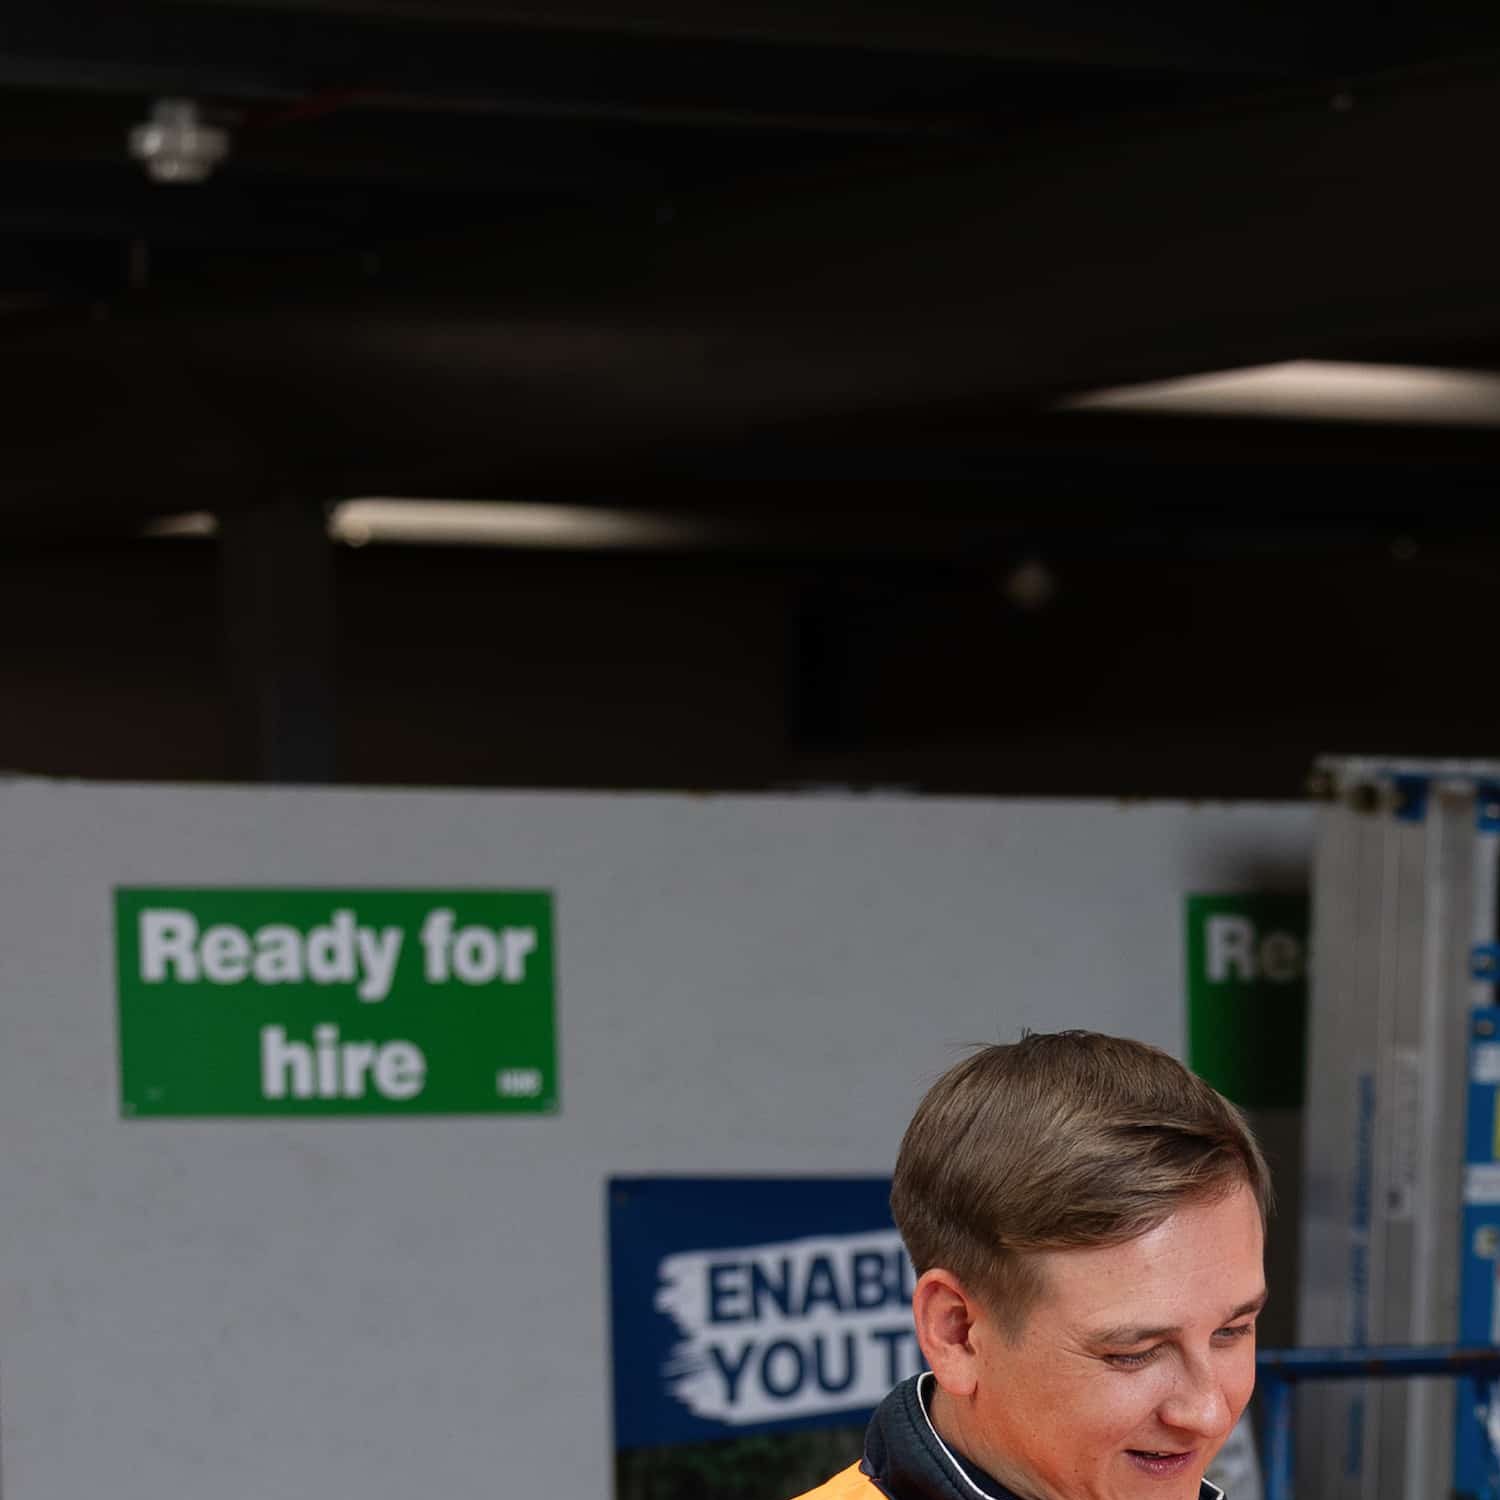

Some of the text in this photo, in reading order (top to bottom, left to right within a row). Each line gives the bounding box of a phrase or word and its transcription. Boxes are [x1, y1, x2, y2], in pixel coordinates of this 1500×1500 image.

[139, 908, 537, 1000] Ready for
[1204, 914, 1308, 983] Re
[261, 1026, 426, 1100] hire
[707, 1245, 915, 1324] ENABL
[709, 1329, 931, 1404] YOU T
